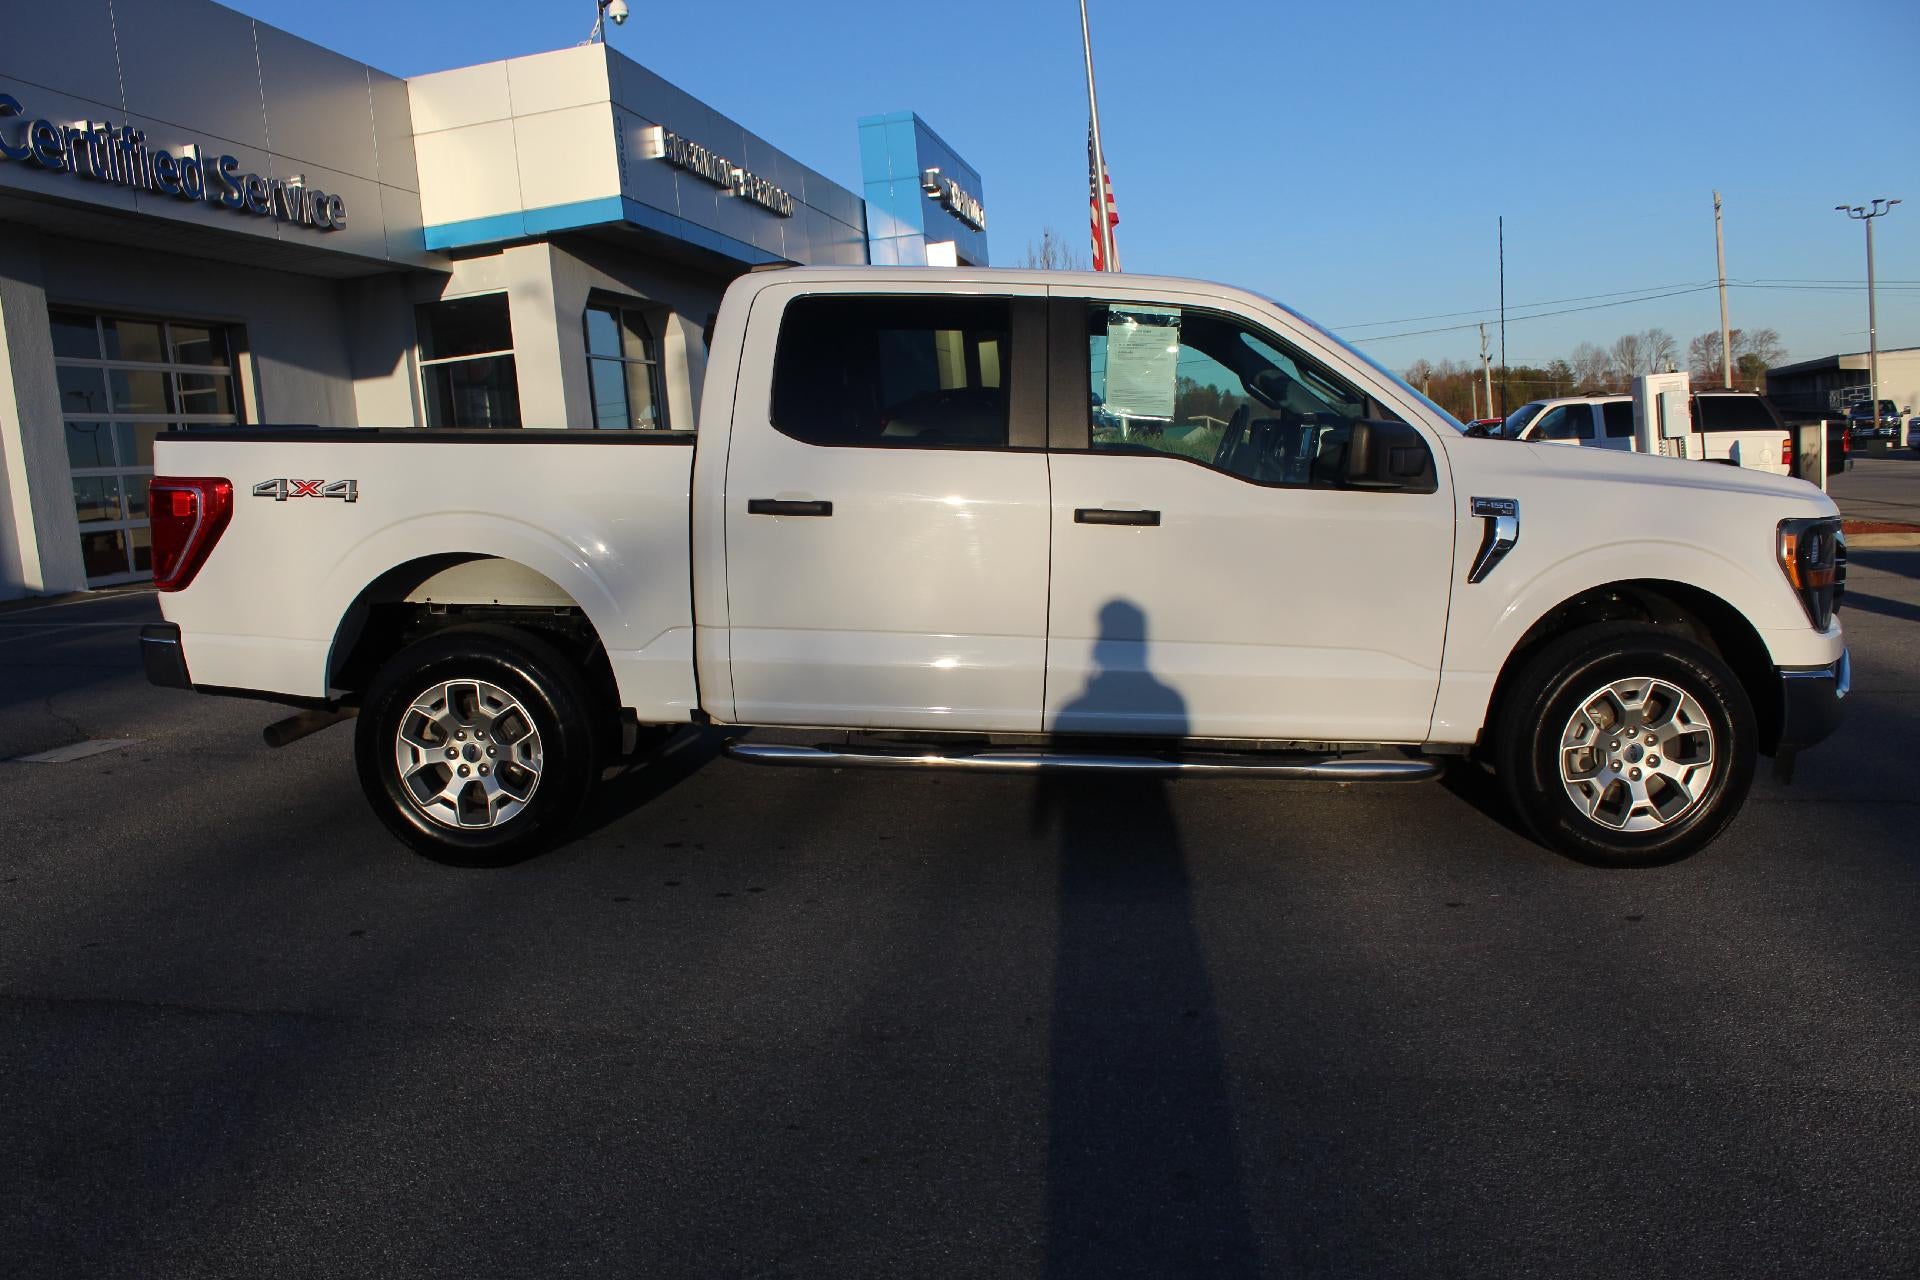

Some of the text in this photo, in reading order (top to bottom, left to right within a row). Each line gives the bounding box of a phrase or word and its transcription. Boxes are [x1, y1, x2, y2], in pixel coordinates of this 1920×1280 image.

[0, 92, 348, 231] Certified Service
[1476, 500, 1514, 510] F-150
